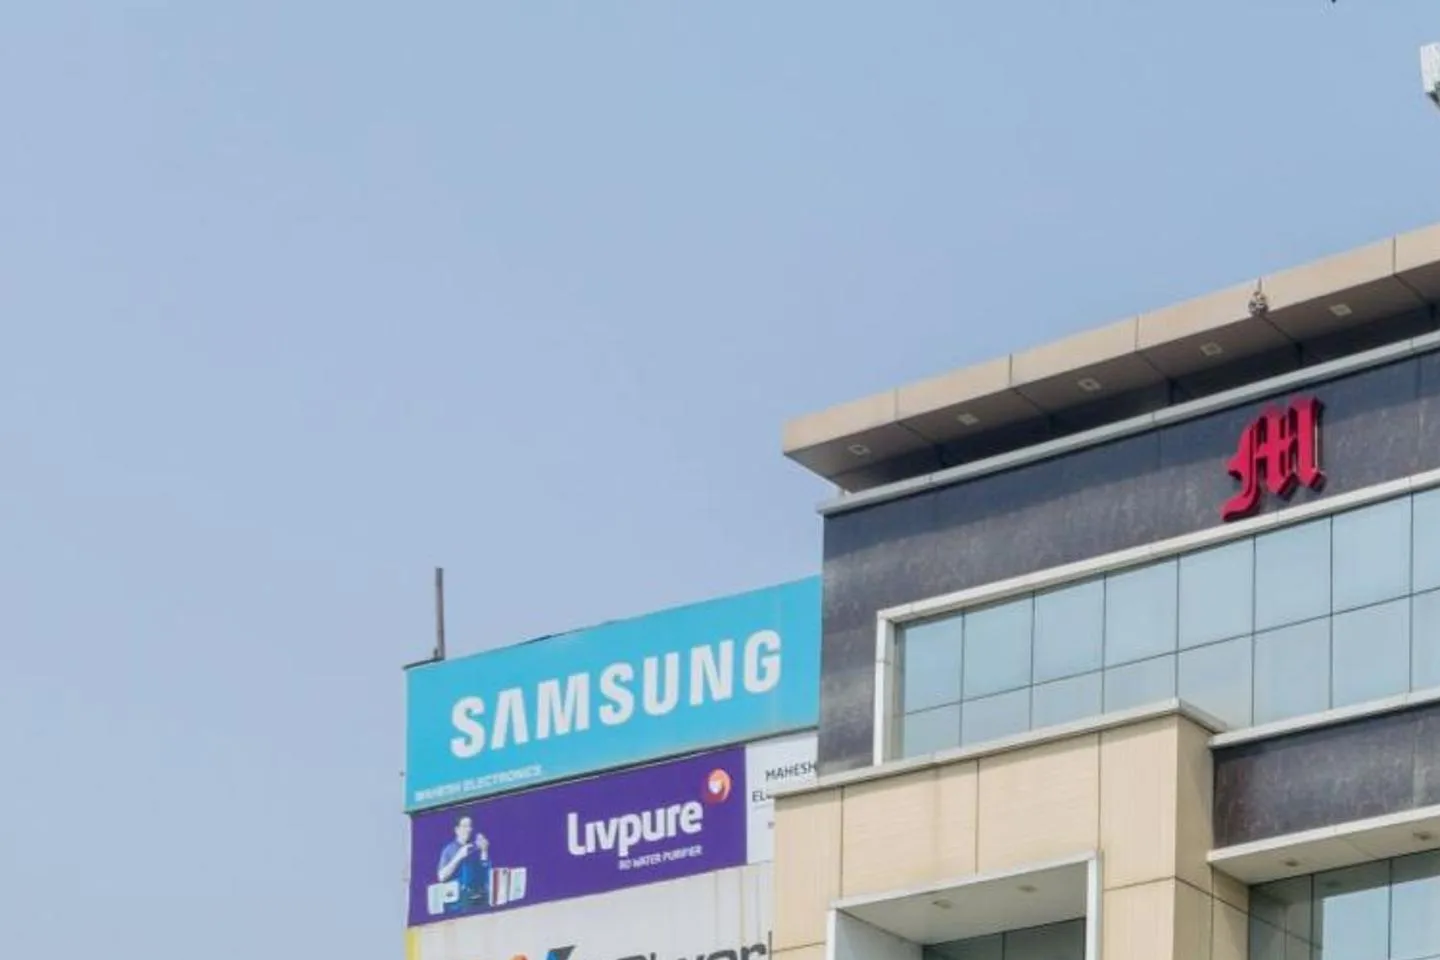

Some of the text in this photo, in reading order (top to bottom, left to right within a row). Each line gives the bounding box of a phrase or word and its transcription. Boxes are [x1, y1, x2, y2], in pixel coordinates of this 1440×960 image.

[450, 629, 781, 759] SAMSUNG
[765, 762, 818, 782] MAHESH
[567, 800, 704, 857] Livpure
[632, 853, 662, 868] WATER
